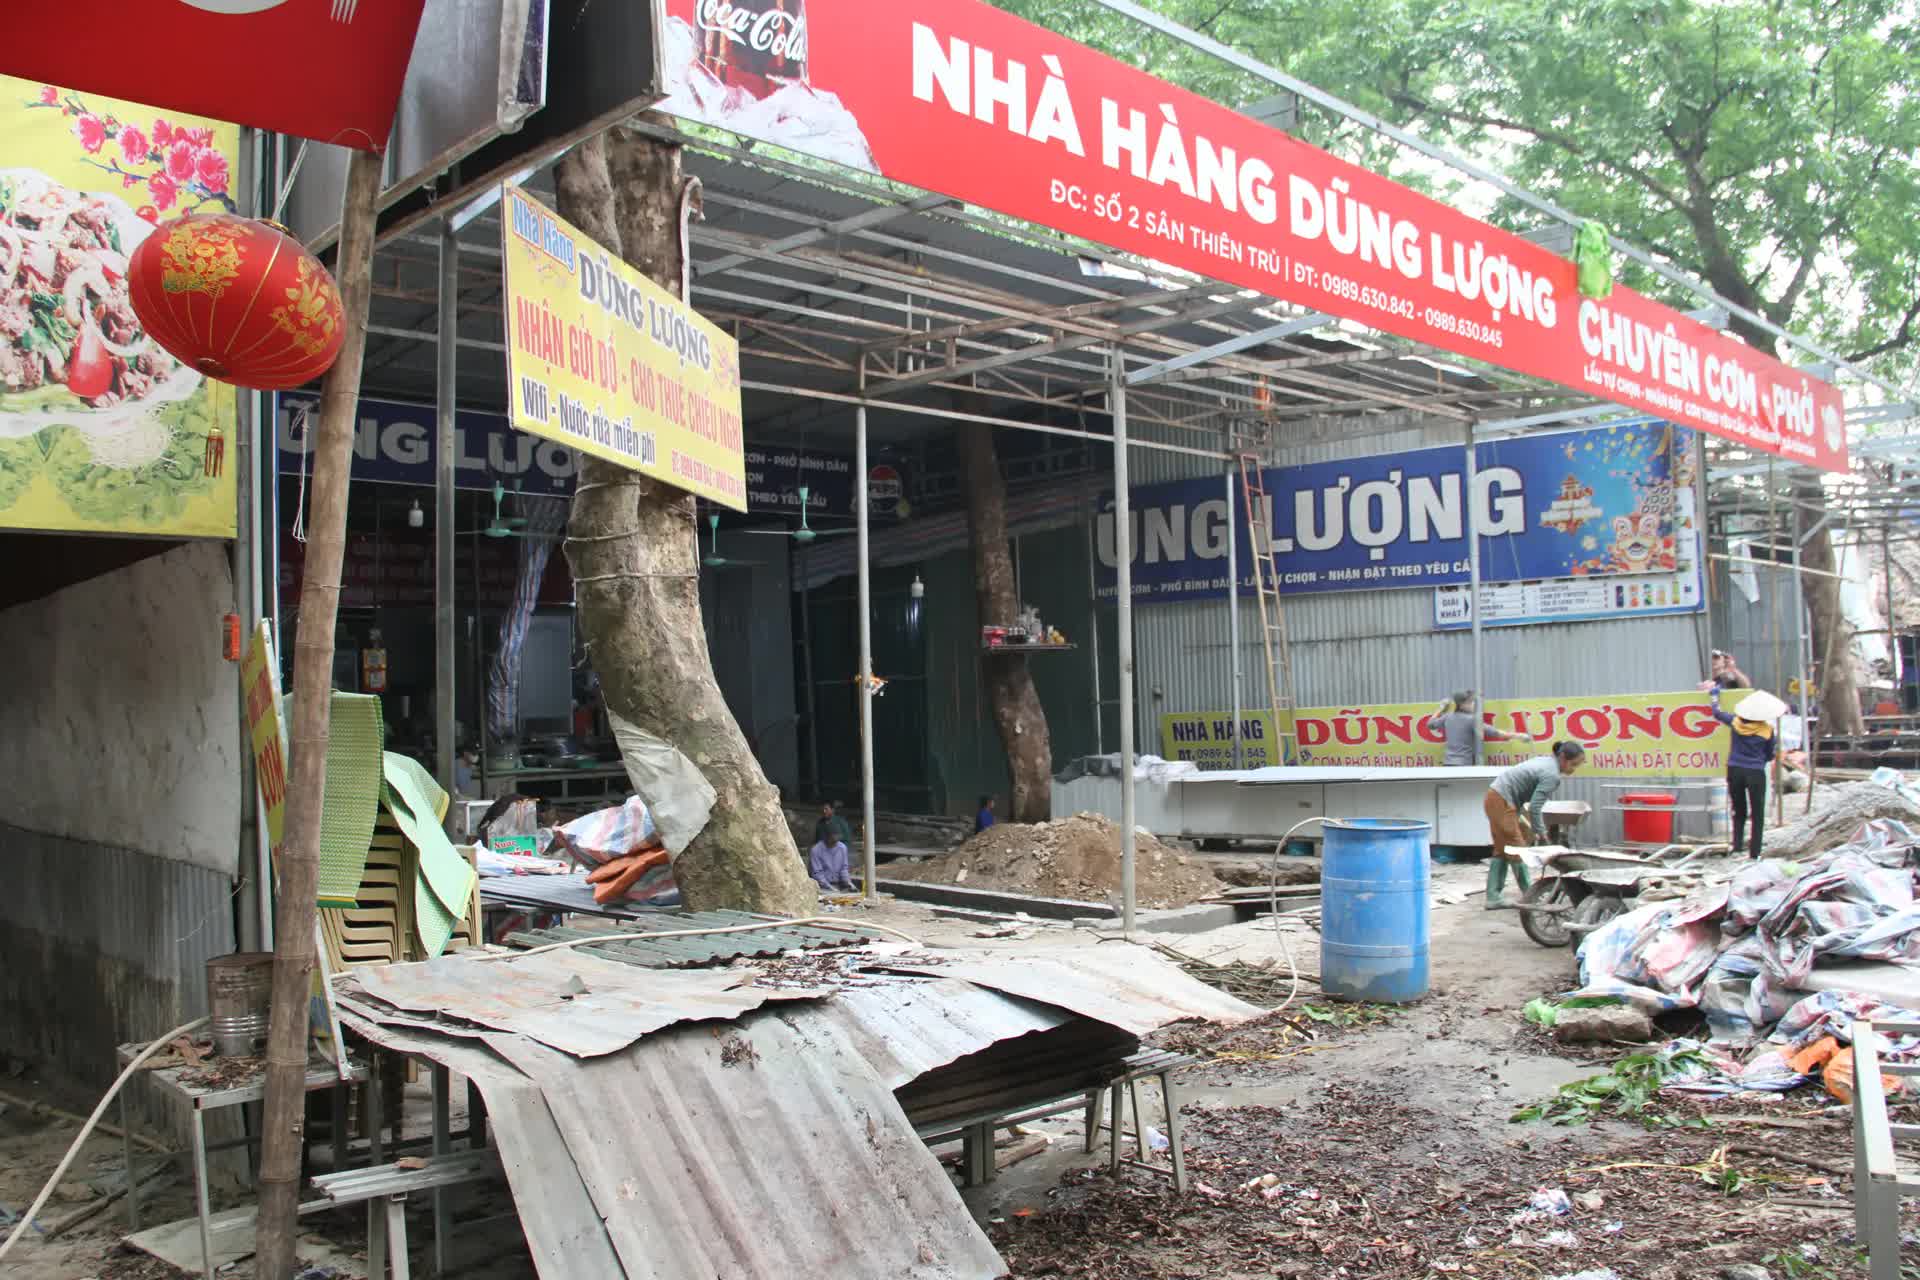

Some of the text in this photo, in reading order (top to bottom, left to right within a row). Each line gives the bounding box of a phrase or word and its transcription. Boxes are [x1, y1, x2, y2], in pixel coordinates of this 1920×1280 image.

[697, 0, 807, 62] Coca-Cola
[911, 21, 1558, 329] NHÀ HÀNG DŨNG LƯỢNG
[513, 195, 575, 272] Nhà Hàng
[1050, 179, 1087, 212] ĐC:
[1094, 192, 1123, 222] SỐ
[1127, 206, 1140, 229] 2
[1145, 211, 1185, 244] SÂN
[1190, 225, 1243, 263] THIÊN
[1247, 246, 1280, 275] TRÙ
[1294, 262, 1319, 288] ĐT:
[1321, 272, 1415, 320] 0989.630.842
[1424, 307, 1503, 349] 0989.630.845
[578, 252, 712, 371] DŨNG LƯỢNG
[517, 295, 565, 375] NHẬN
[631, 356, 656, 413] CHO
[1578, 300, 1701, 396] CHUYÊN
[1704, 353, 1757, 416] CƠM
[1772, 377, 1815, 437] PHỞ
[521, 377, 548, 422] Wifi
[560, 393, 590, 438] Nước
[613, 416, 639, 457] miễn
[1328, 568, 1360, 583] NHẬN
[1363, 565, 1386, 581] ĐẶT
[1390, 564, 1422, 577] THEO
[1425, 561, 1449, 575] YÊU
[1172, 715, 1209, 742] NHÀ
[1592, 749, 1638, 770] NHẬN
[1678, 751, 1720, 769] CƠM
